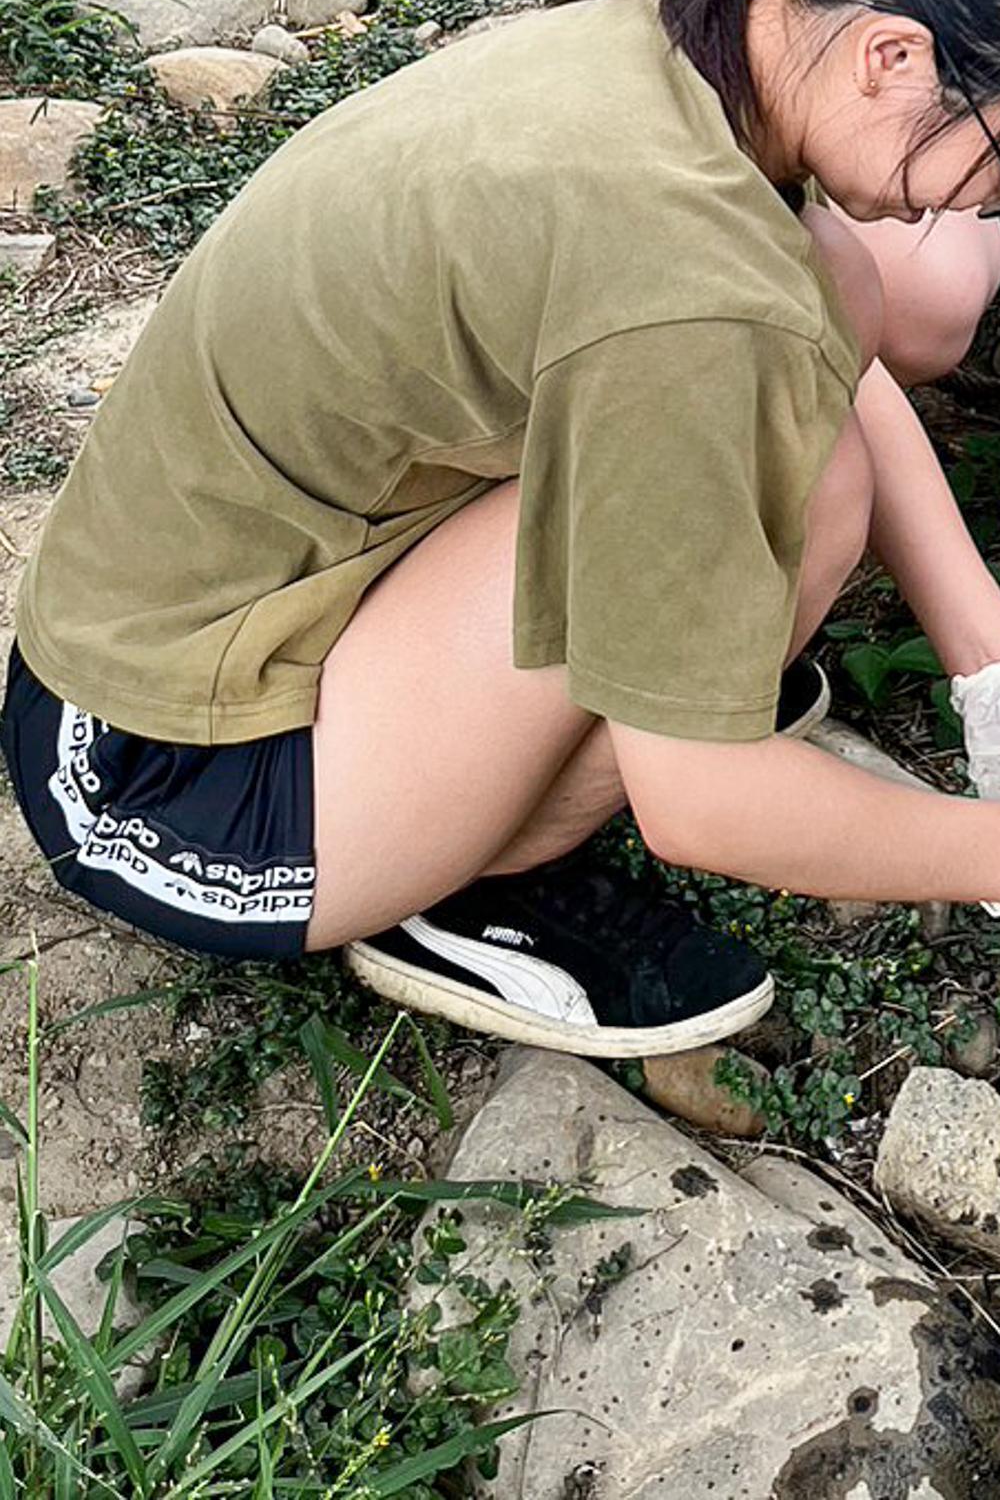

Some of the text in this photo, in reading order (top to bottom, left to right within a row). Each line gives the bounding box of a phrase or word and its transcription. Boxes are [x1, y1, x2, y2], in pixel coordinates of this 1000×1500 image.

[86, 841, 313, 915] adidas adid
[95, 811, 316, 895] adidas adid
[481, 924, 524, 946] PUMA
